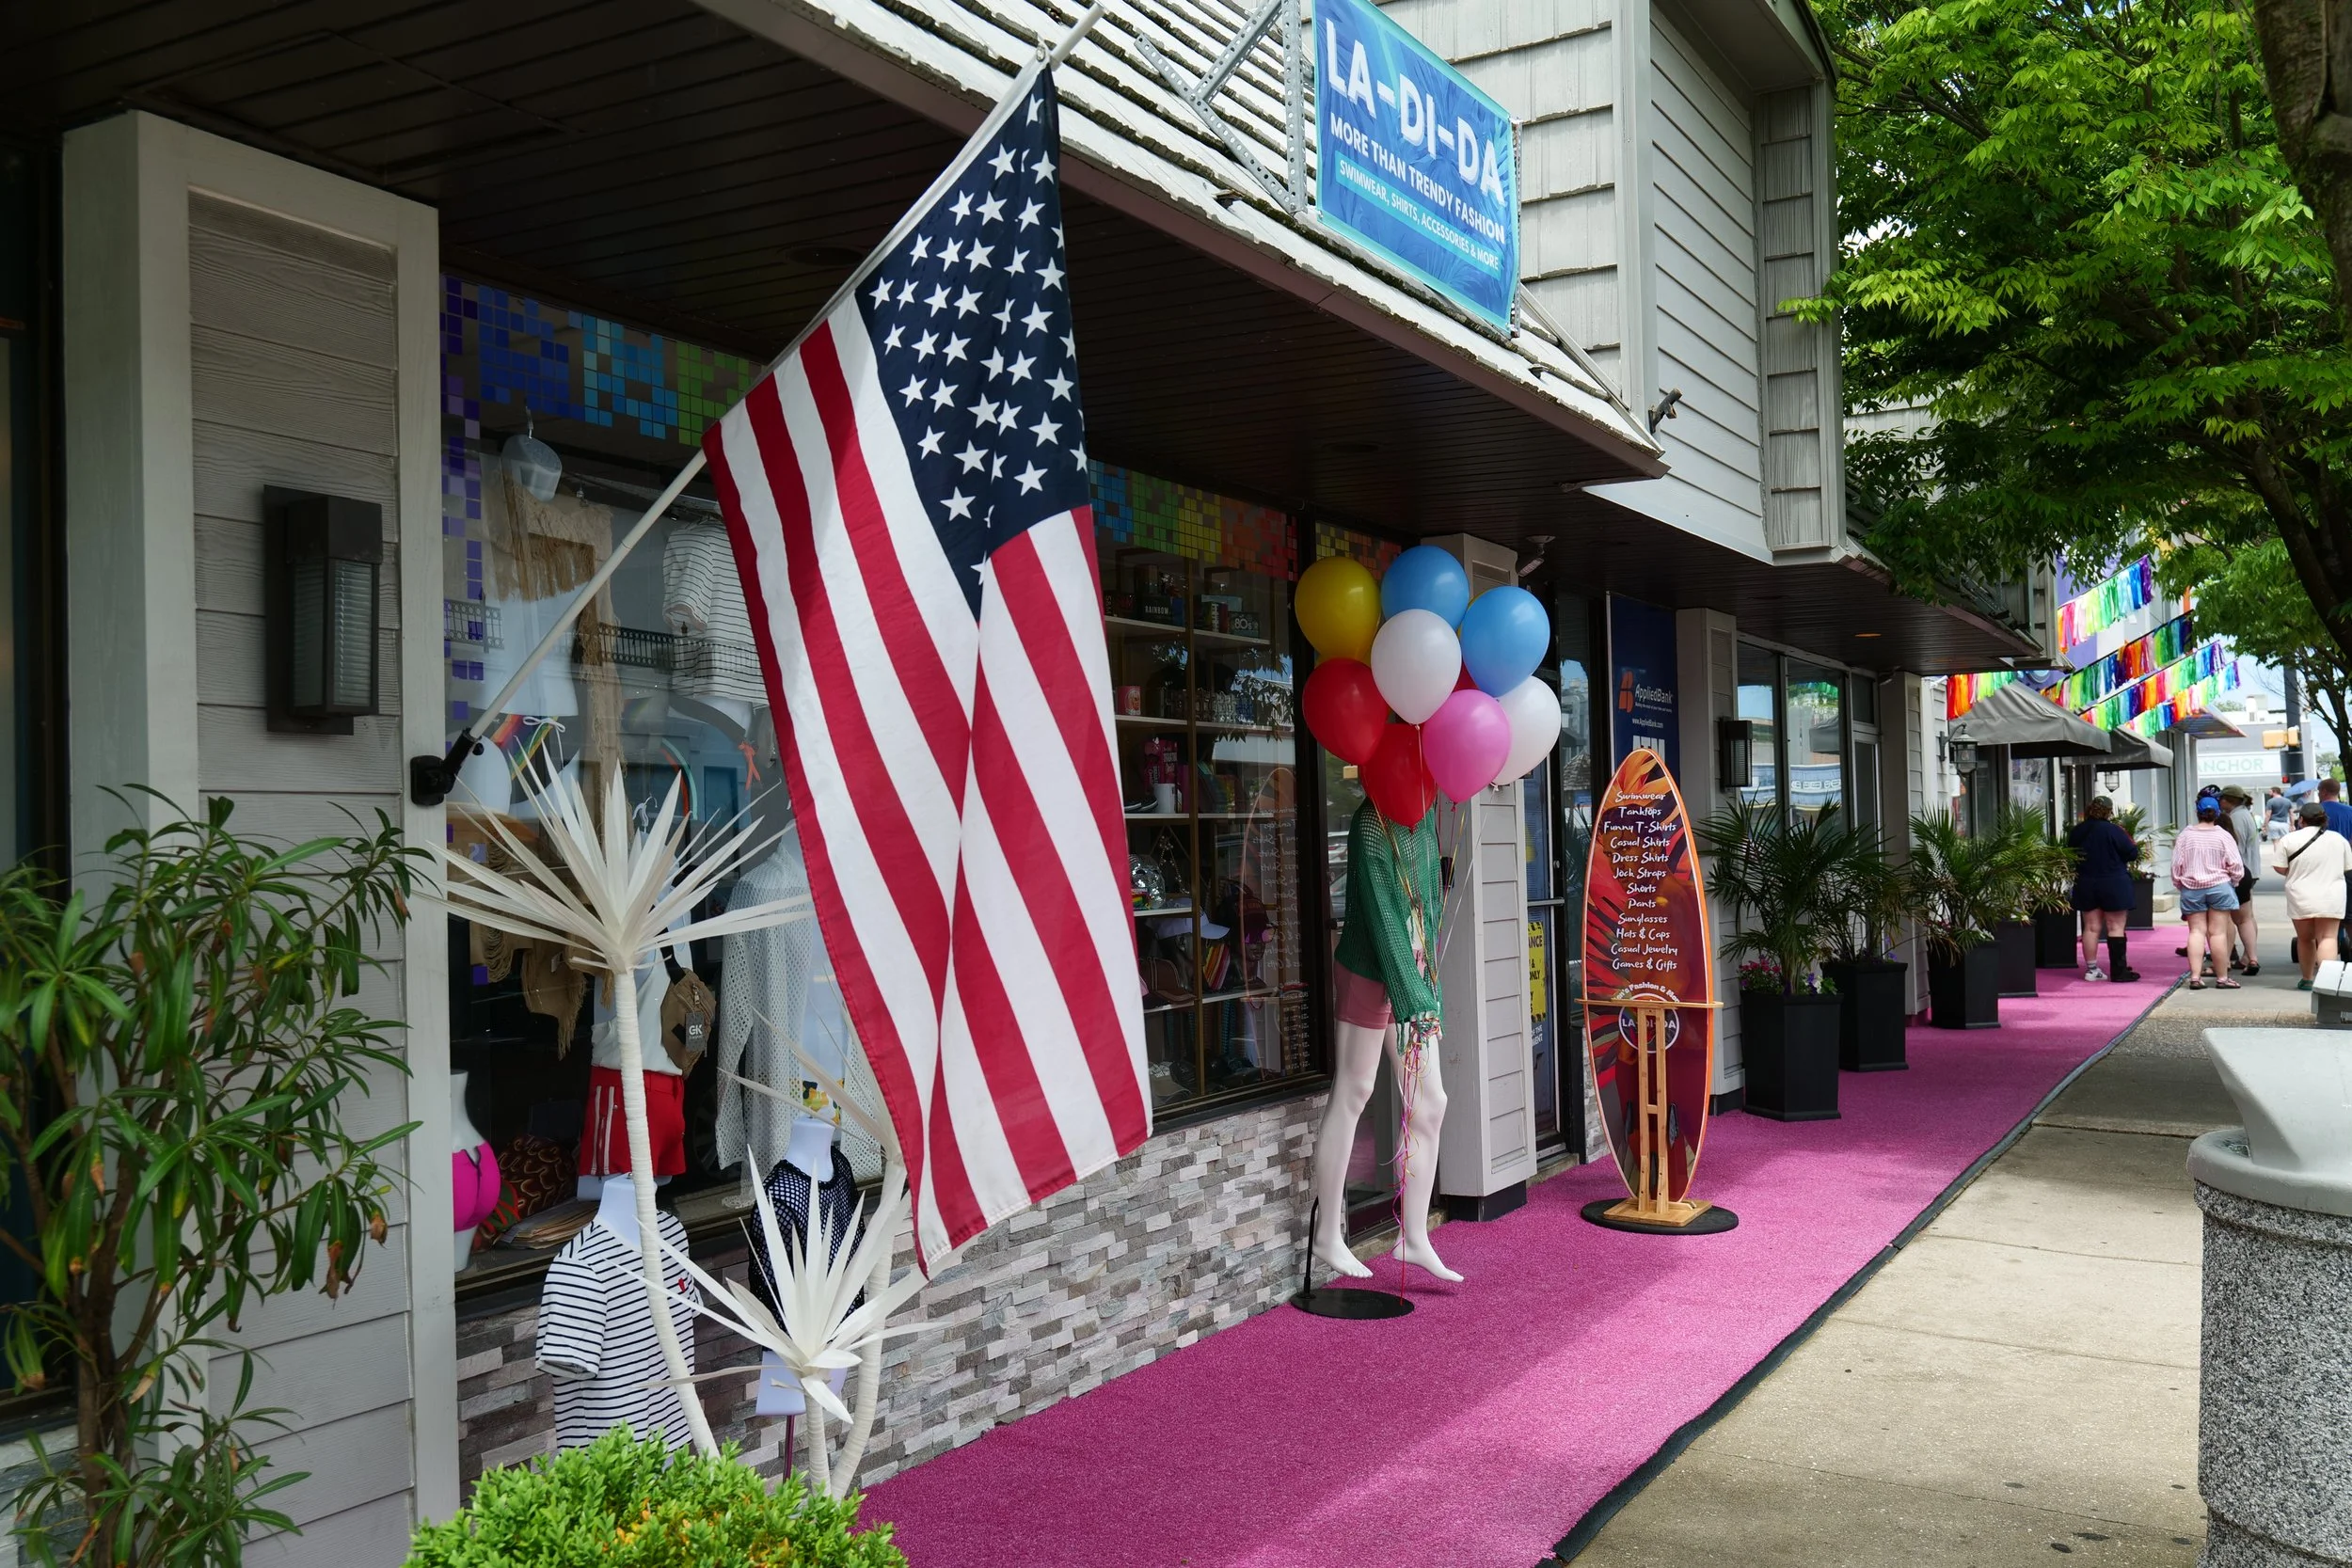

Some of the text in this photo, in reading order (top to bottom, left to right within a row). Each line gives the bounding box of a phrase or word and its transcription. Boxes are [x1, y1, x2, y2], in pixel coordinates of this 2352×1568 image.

[1326, 18, 1505, 207] LA-DI-DA
[1330, 112, 1505, 245] MORE THAN TRENDY FASHION
[1340, 159, 1499, 270] SWIMWEAR, SHIRTS, ACCESSORIES & MORE
[1145, 605, 1168, 614] RAINBOW
[1635, 684, 1672, 704] AppliedBank
[1615, 790, 1666, 802] Swimwear
[1618, 806, 1662, 818] Tanktops
[1603, 820, 1677, 833] Funny T-Shirts
[1610, 836, 1671, 848] Casual Shirts
[1613, 851, 1669, 863] Dress Shirts
[1613, 866, 1667, 880] Jock Straps
[1627, 882, 1657, 895] Shorts
[1628, 897, 1657, 909] Pants
[1618, 912, 1668, 926] Sunglasses
[1616, 927, 1671, 941] Hats & Caps
[1611, 942, 1678, 956] Casual Jewelry
[1612, 958, 1677, 972] Games & Gifts
[1629, 982, 1659, 991] Fashion
[1666, 990, 1680, 1003] Mor
[689, 1024, 703, 1035] GK
